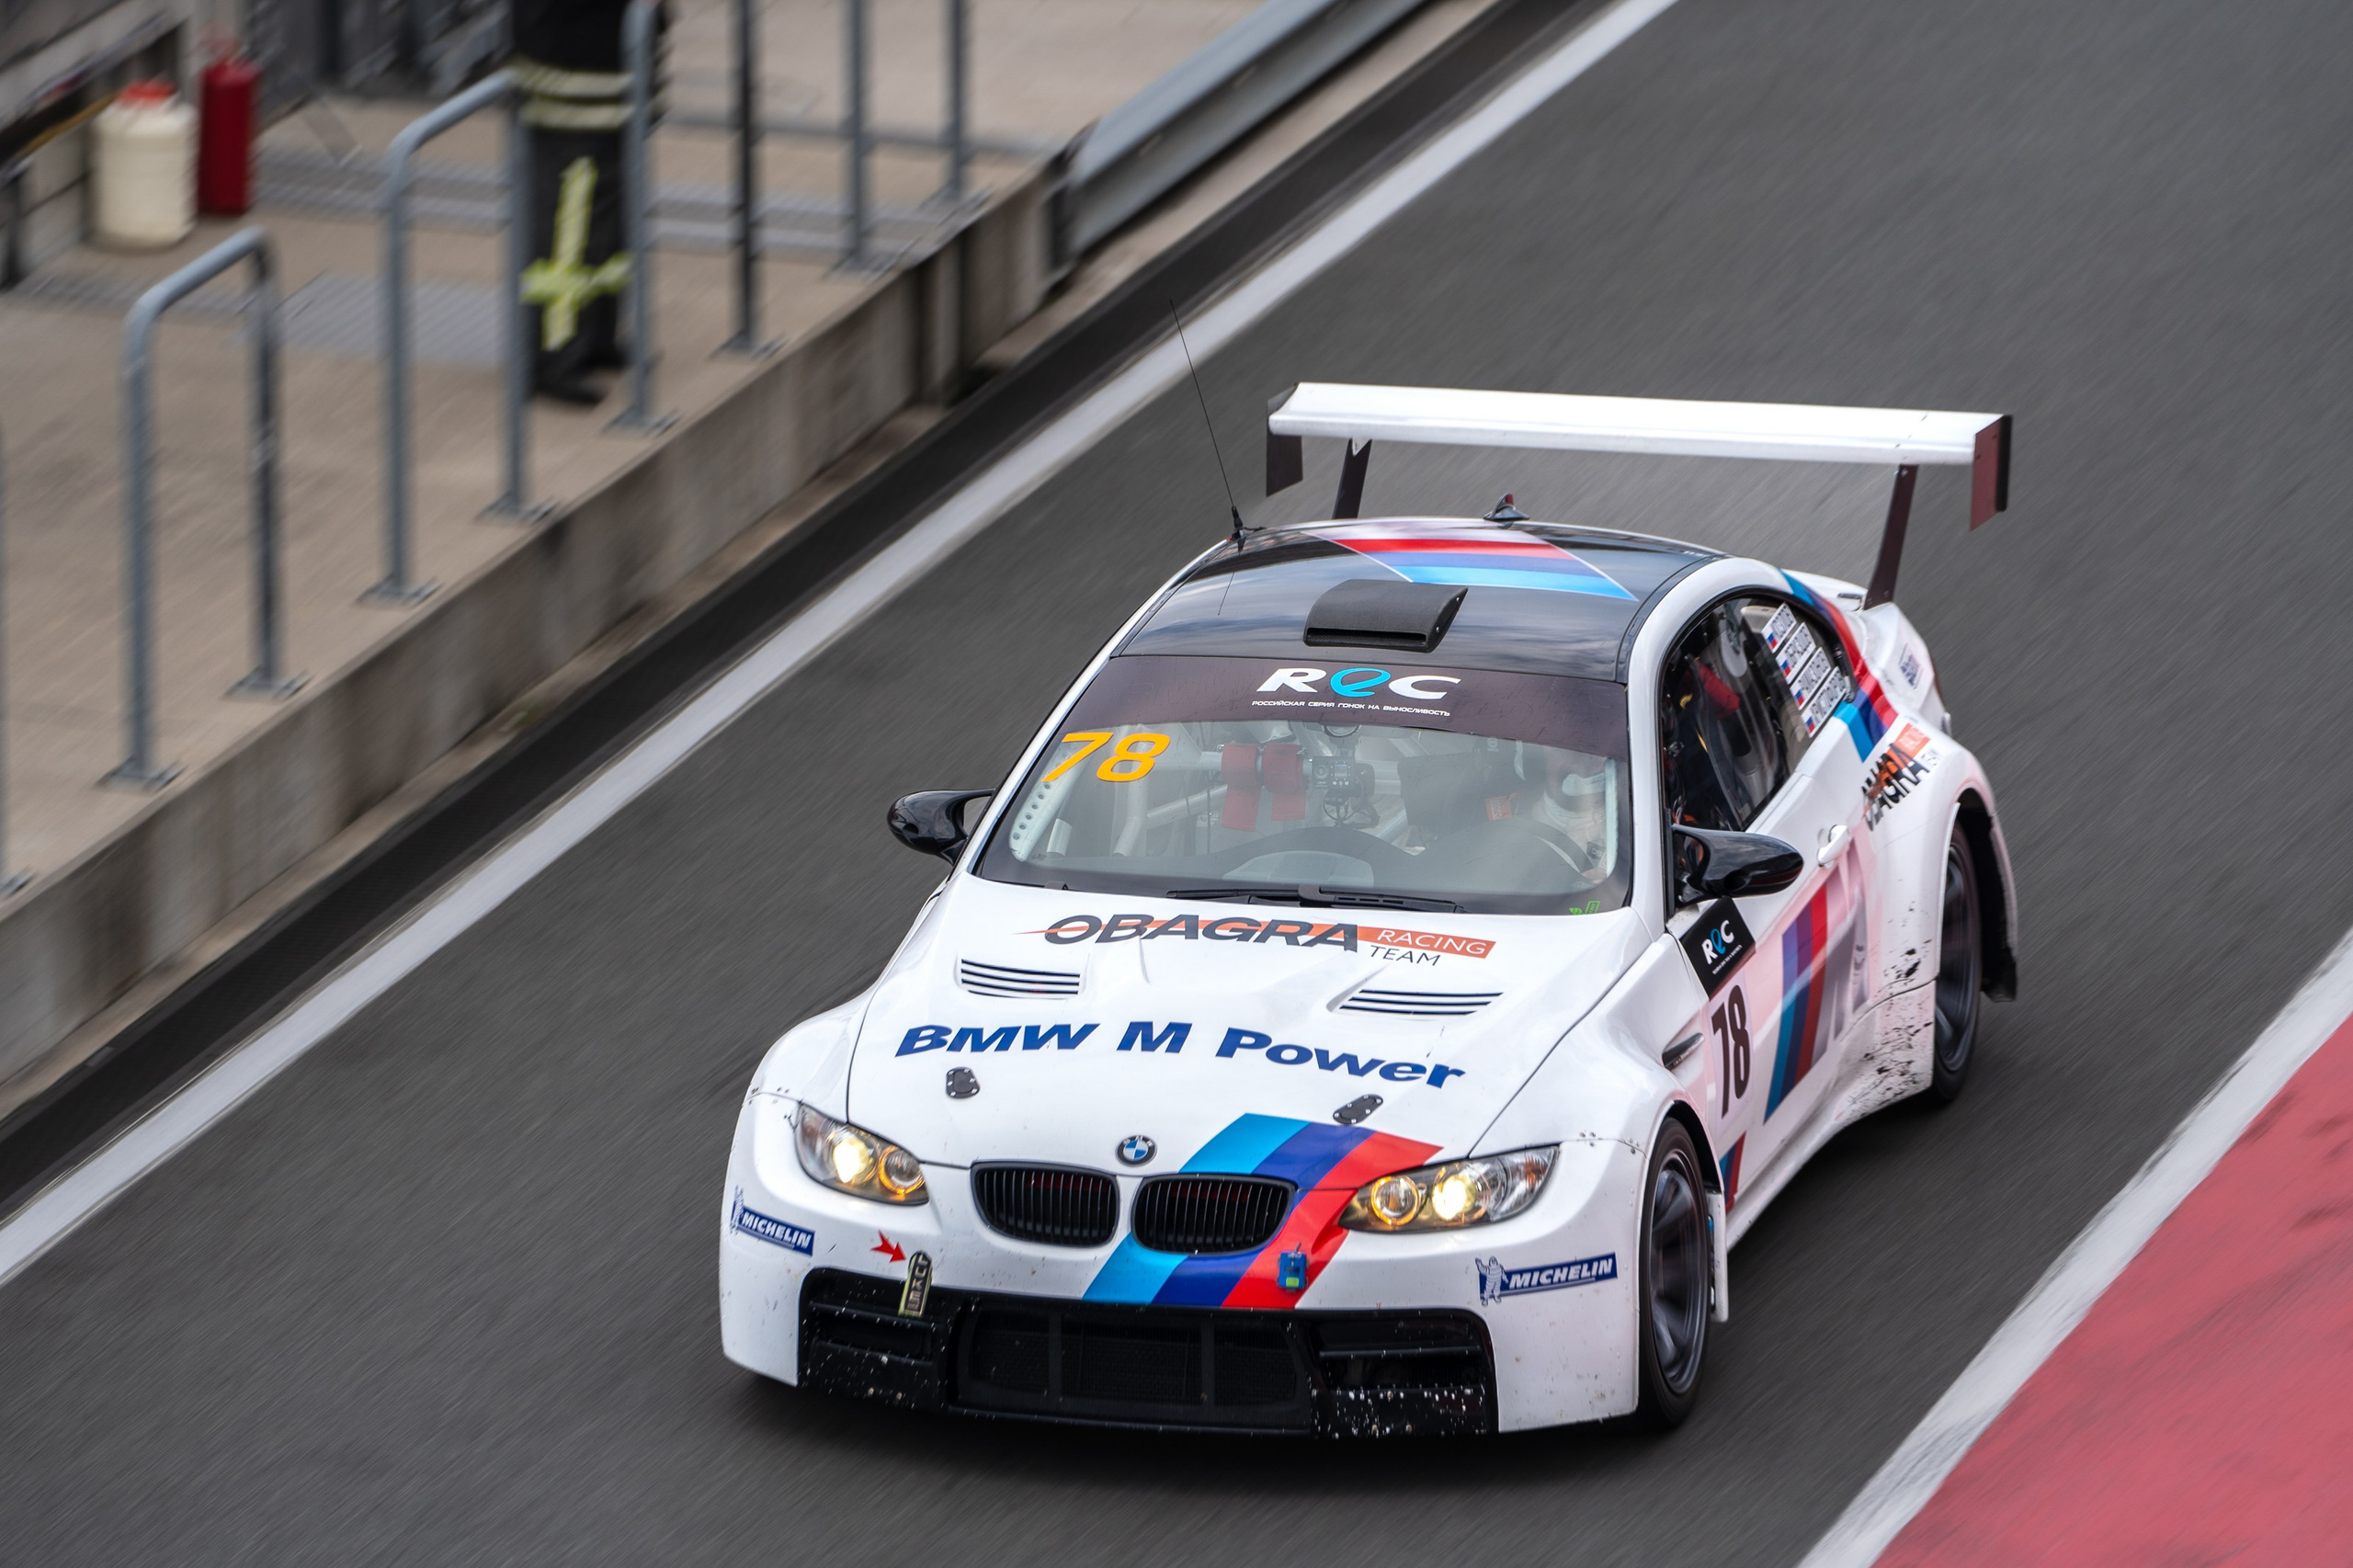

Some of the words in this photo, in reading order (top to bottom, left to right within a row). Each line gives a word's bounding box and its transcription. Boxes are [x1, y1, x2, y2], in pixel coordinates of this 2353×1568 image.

[1383, 706, 1450, 717] ВЫНОСЛИВОСТЬ
[1040, 732, 1171, 782] 78
[1044, 914, 1358, 953] OBAGRA
[1377, 929, 1487, 955] RACING
[1370, 945, 1440, 966] TEAM
[894, 1023, 1101, 1058] BMW
[1116, 1021, 1193, 1053] M
[1215, 1027, 1466, 1089] Power
[1711, 984, 1751, 1119] 78
[741, 1211, 813, 1249] MICHELIN
[1508, 1258, 1613, 1290] MICHELIN
